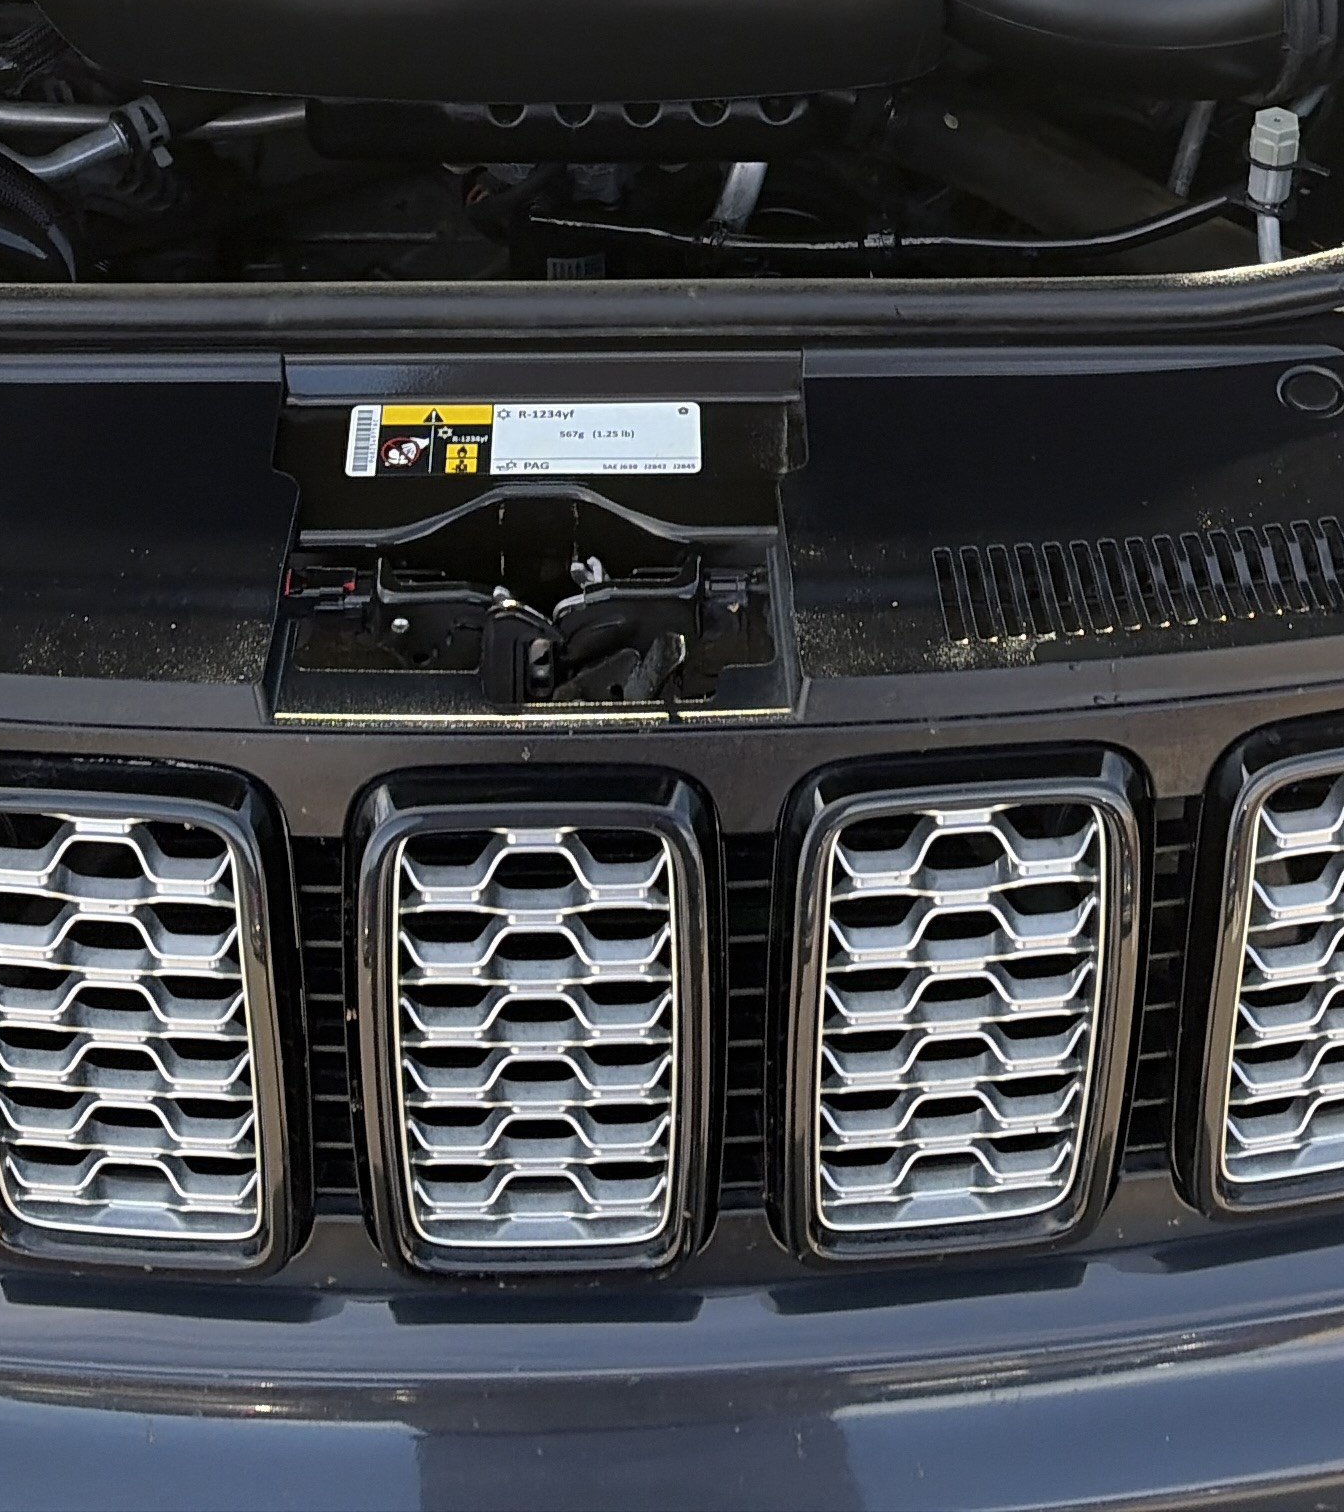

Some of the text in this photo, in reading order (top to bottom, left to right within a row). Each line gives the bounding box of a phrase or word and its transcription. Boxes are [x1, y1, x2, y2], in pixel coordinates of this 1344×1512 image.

[518, 409, 575, 420] R-1234yf
[559, 430, 635, 439] 567g (1.25 lb)
[523, 462, 550, 470] PAG
